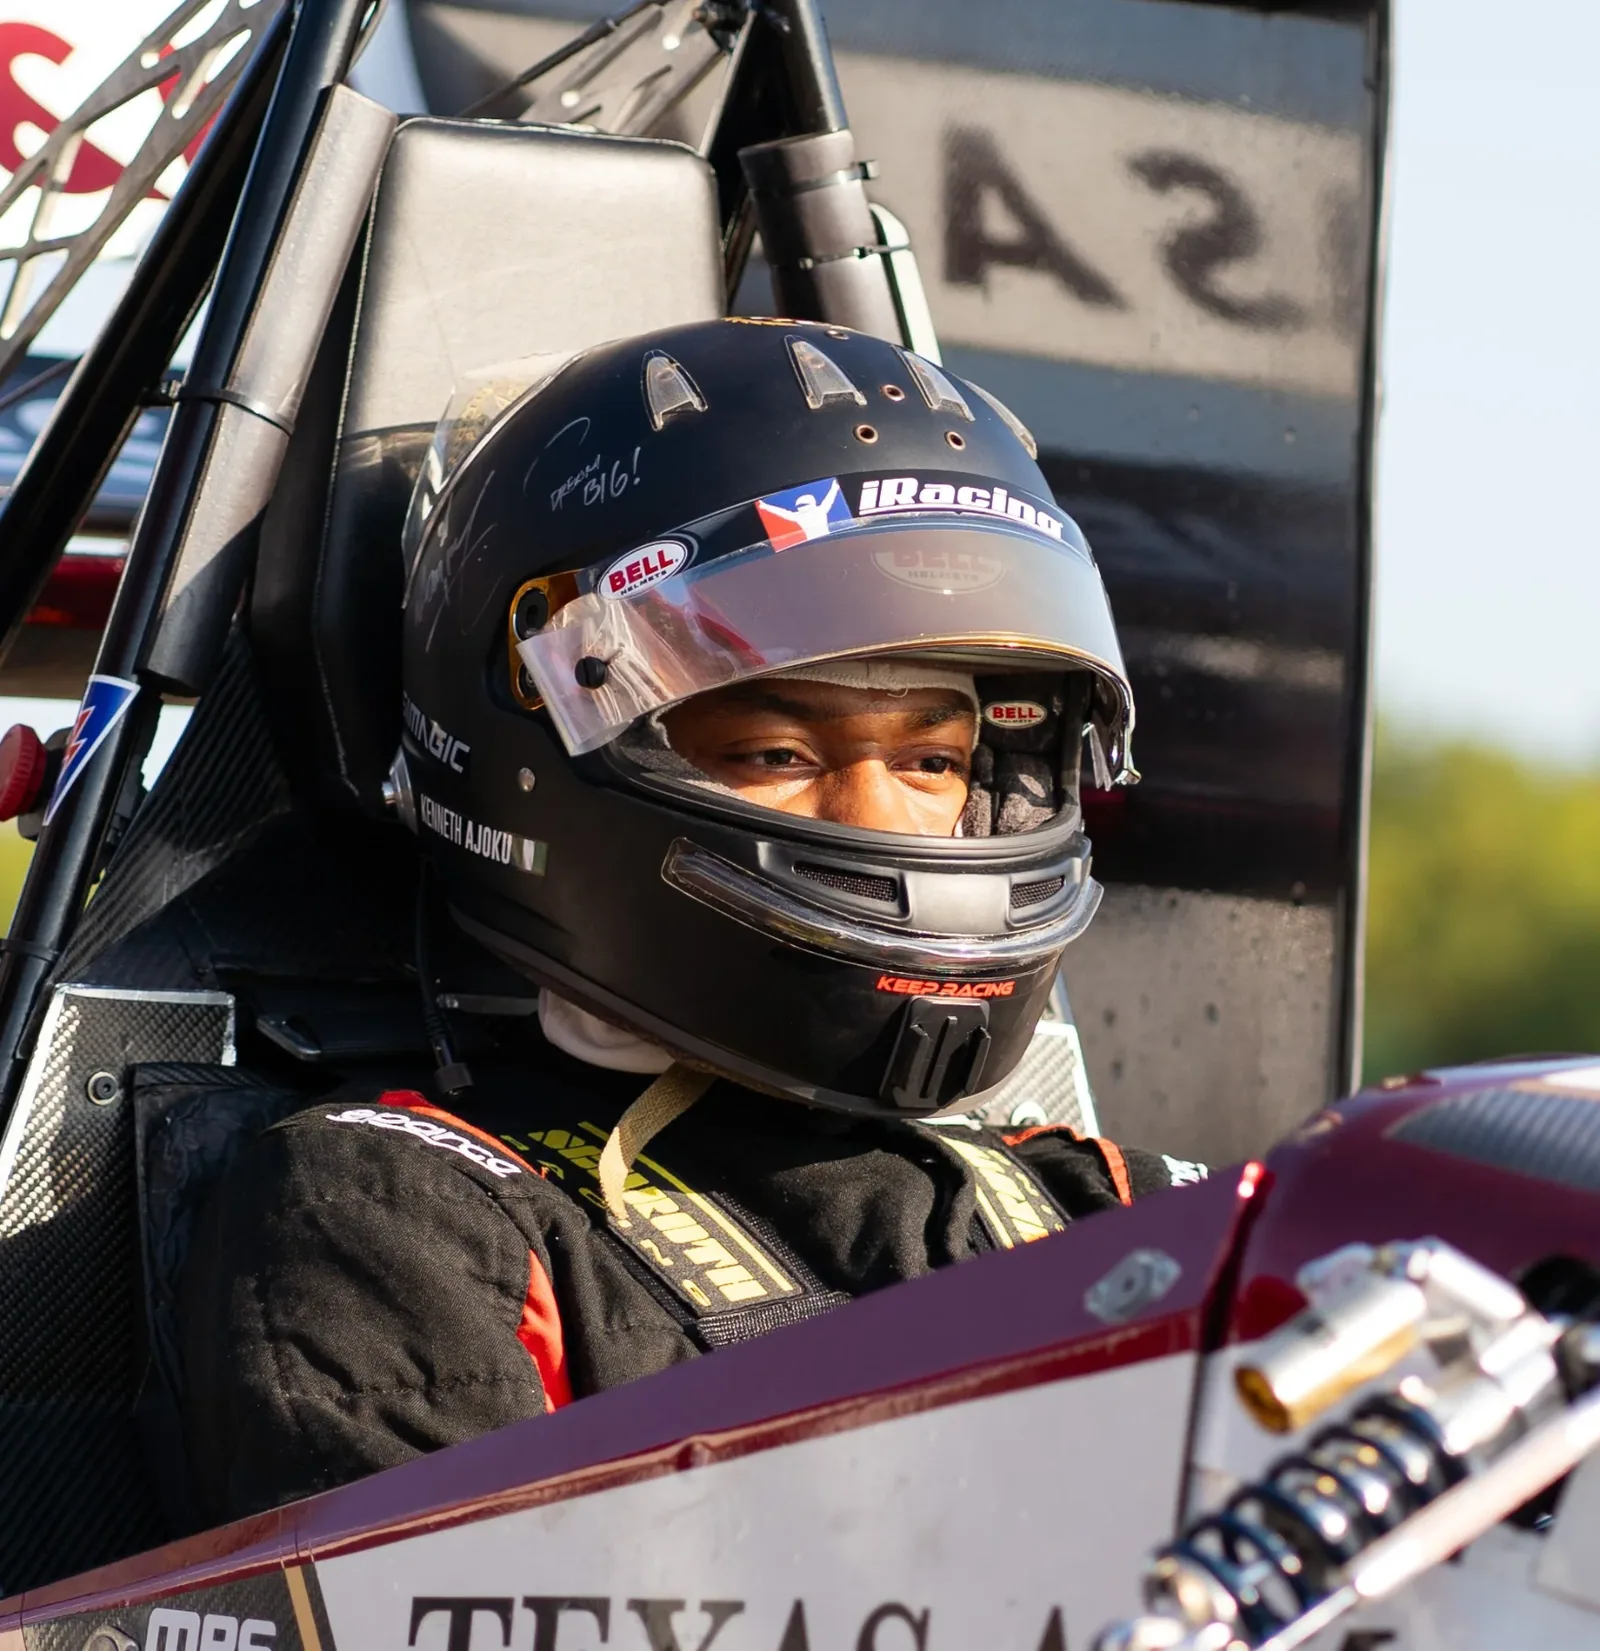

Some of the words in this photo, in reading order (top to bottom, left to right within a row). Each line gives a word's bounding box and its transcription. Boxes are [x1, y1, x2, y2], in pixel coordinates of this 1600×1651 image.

[859, 477, 1064, 541] iRacing
[608, 549, 674, 593] BELL
[620, 570, 667, 596] HELMETS
[992, 707, 1037, 719] BELL
[420, 793, 463, 846] KENNETH
[465, 820, 513, 865] AJOKU
[876, 975, 940, 995] KEEP
[940, 980, 1016, 997] RACING
[325, 1108, 523, 1179] sparco
